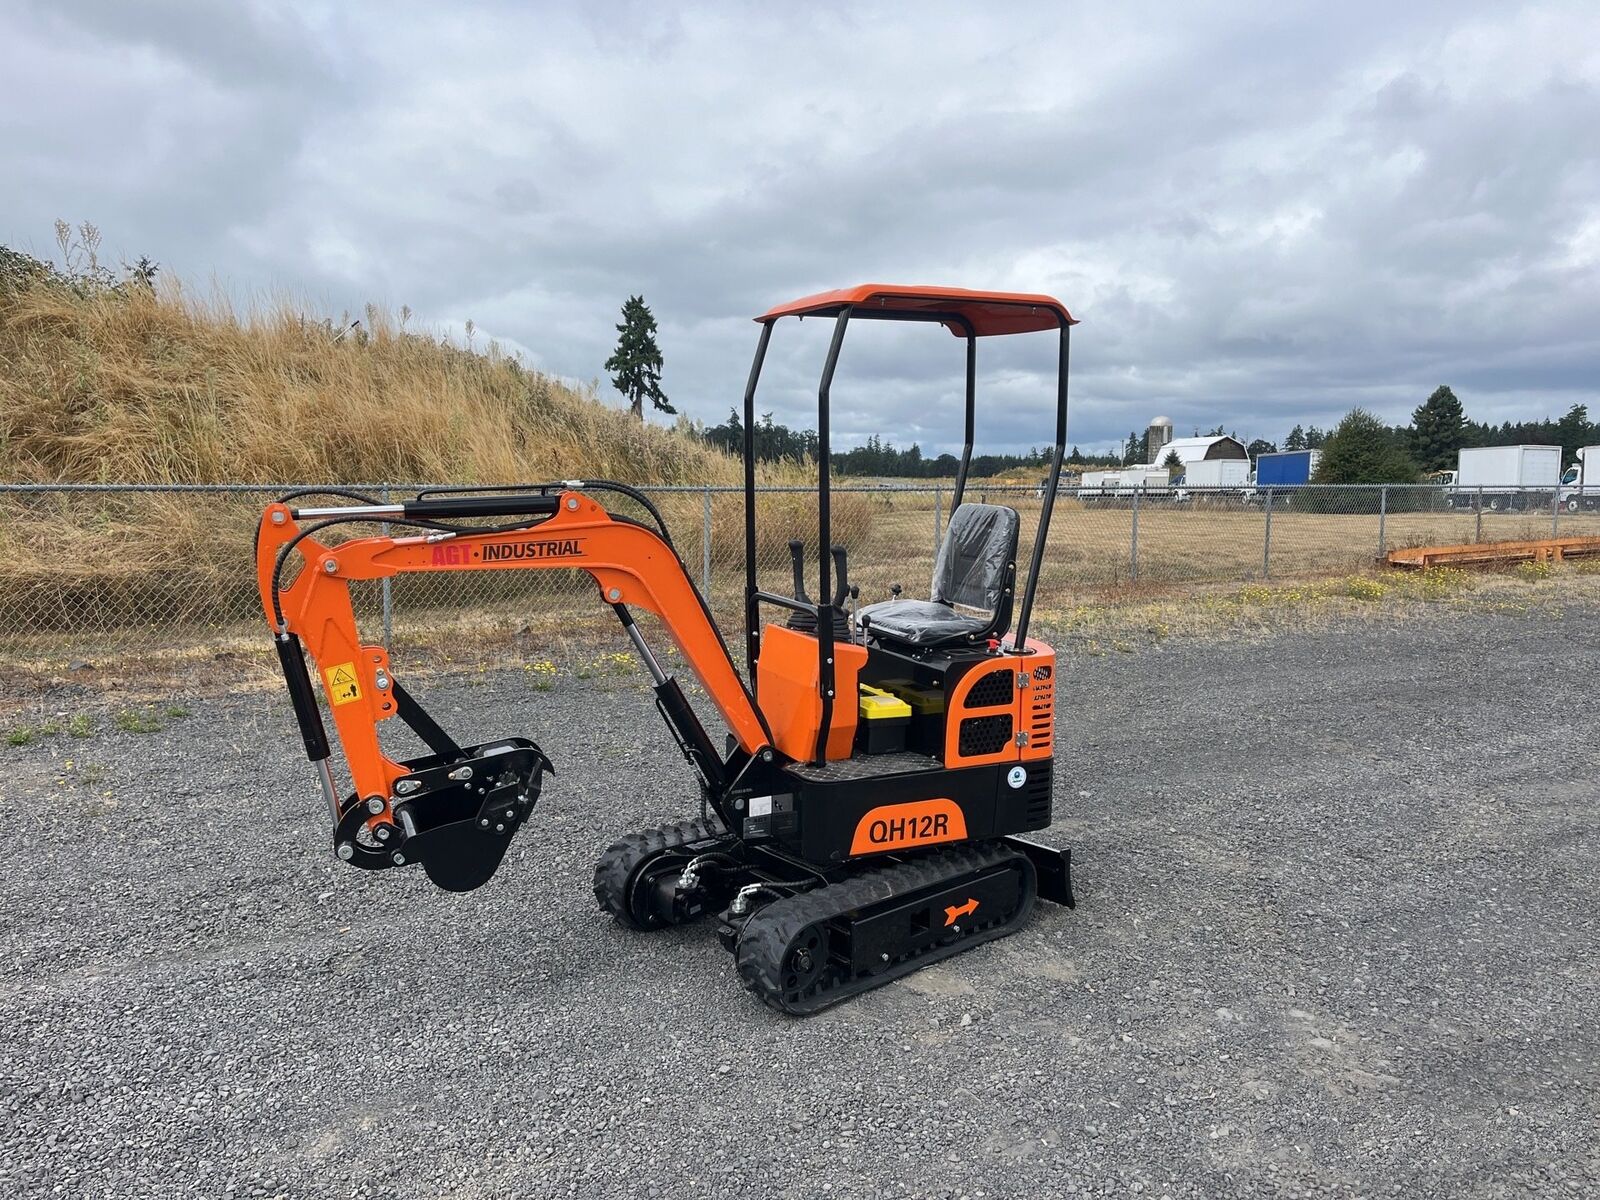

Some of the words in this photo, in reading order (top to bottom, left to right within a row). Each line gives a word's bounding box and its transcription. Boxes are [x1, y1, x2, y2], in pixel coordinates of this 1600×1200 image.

[431, 544, 471, 566] AGT
[482, 540, 582, 560] INDUSTRIAL
[869, 813, 949, 843] QH12R
